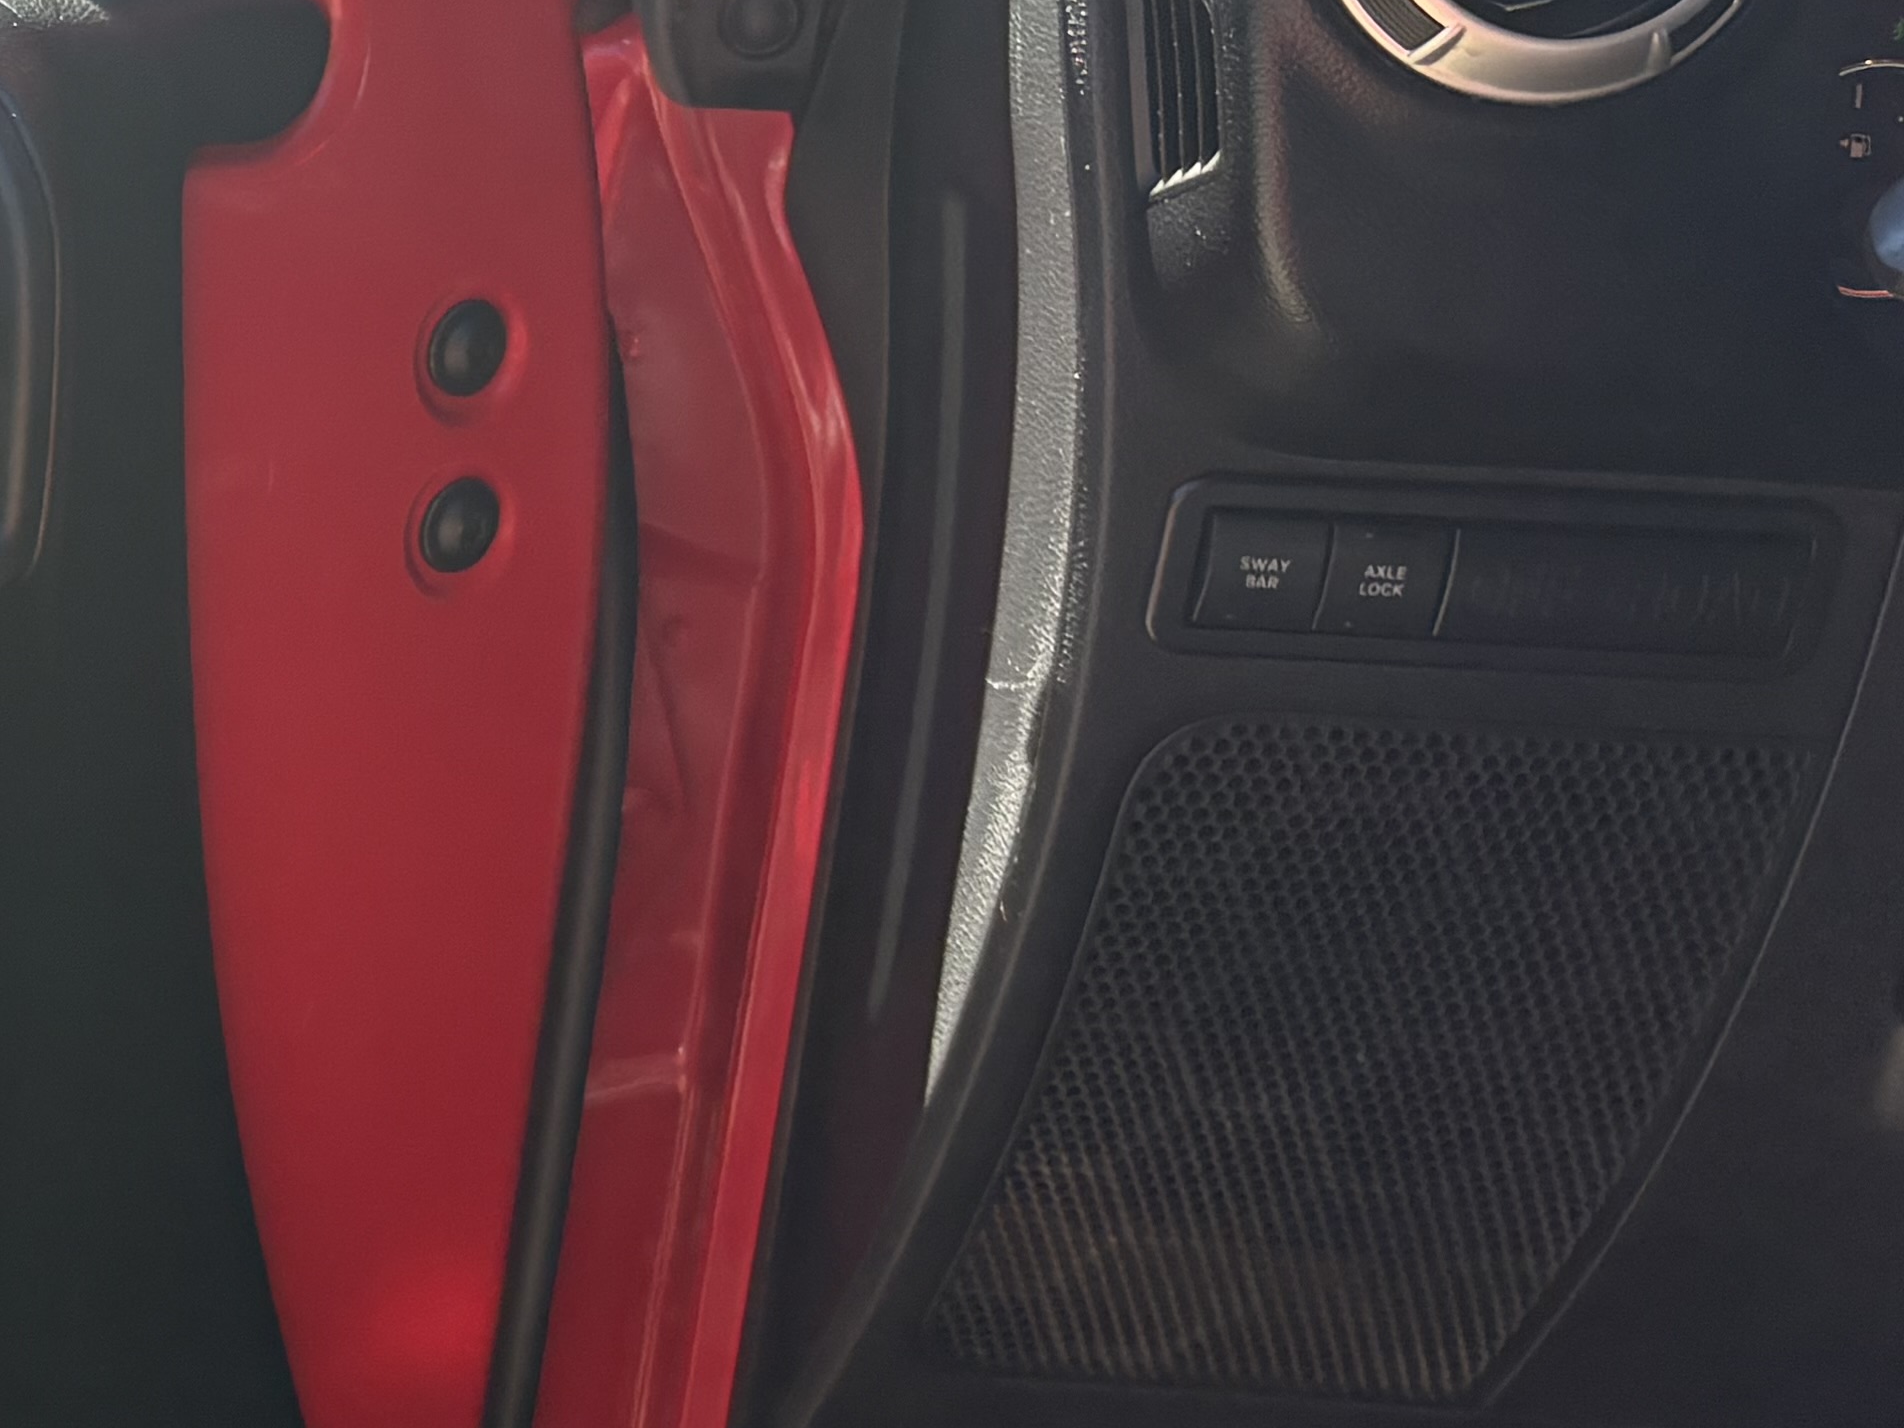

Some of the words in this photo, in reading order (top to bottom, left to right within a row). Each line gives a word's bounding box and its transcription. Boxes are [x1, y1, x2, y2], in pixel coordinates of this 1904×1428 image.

[1239, 555, 1291, 573] SWAY
[1363, 564, 1408, 580] AXLE
[1245, 573, 1280, 589] BAR
[1358, 581, 1406, 597] LOCK
